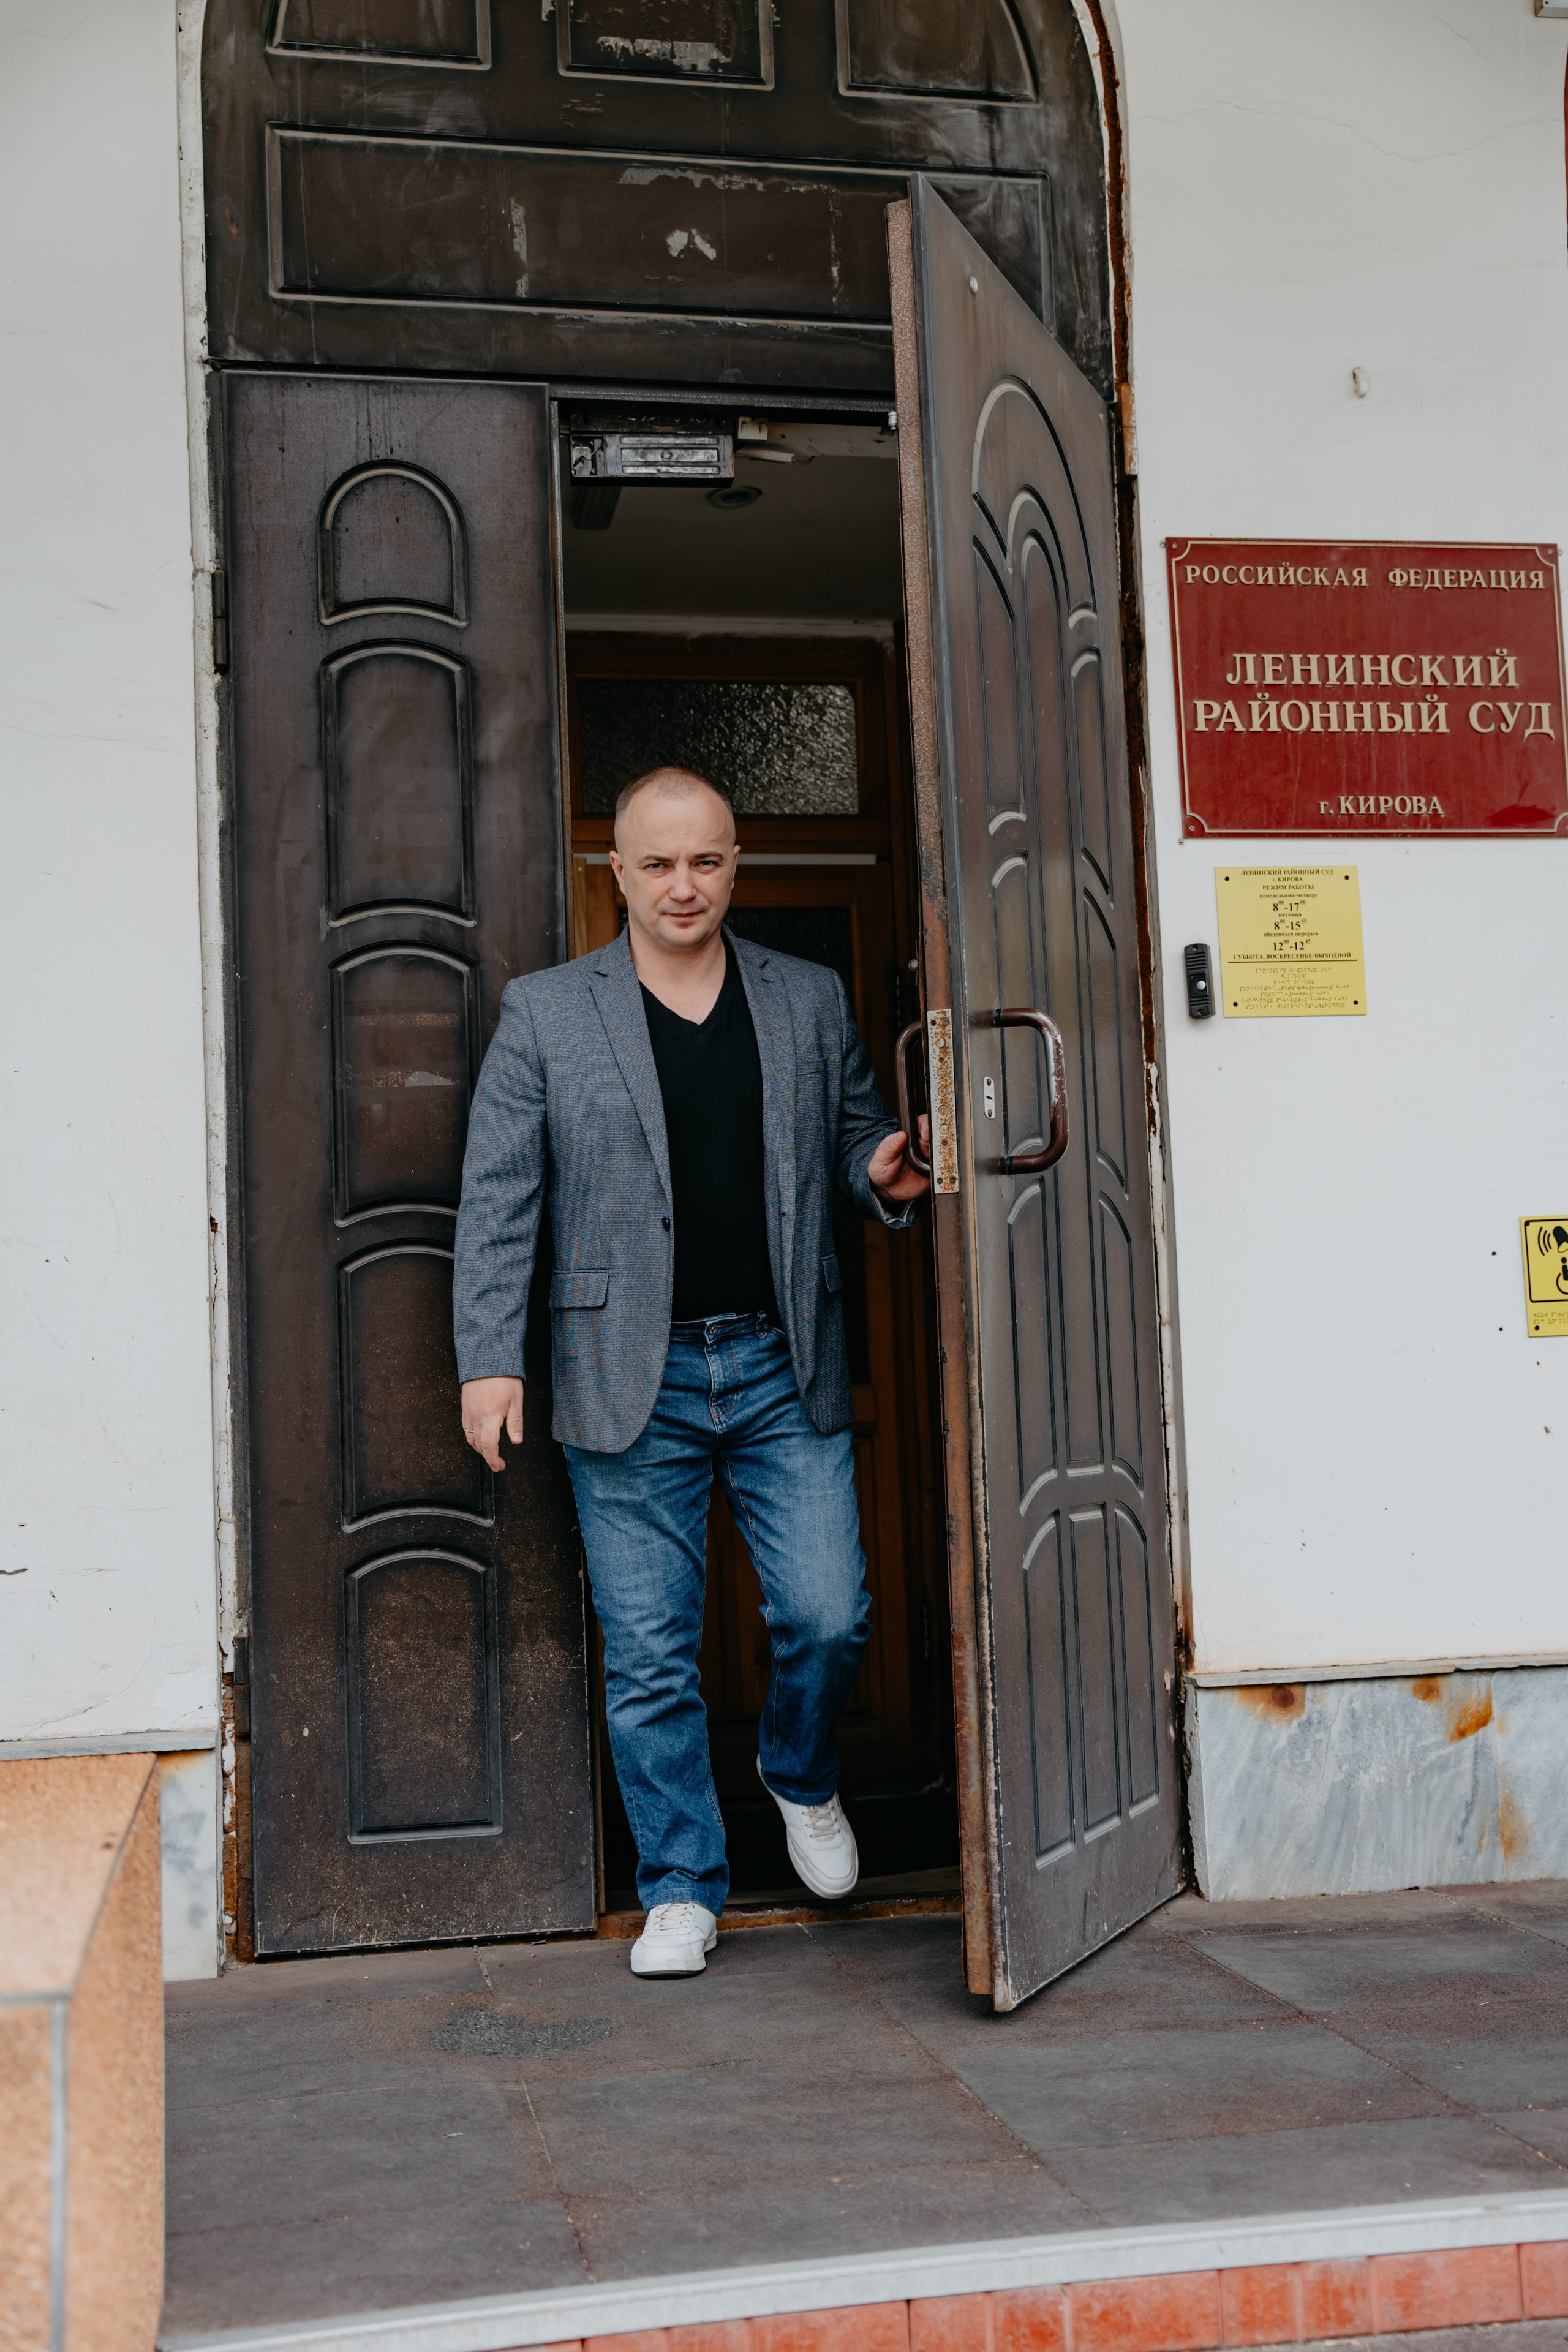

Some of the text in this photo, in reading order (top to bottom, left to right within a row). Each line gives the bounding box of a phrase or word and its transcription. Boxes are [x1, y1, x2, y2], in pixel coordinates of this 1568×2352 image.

[1185, 562, 1545, 592] РОССИЙСКАЯ ФЕДЕРАЦИЯ
[1226, 649, 1520, 688] ЛЕНИНСКИЙ
[1193, 693, 1555, 741] РАЙОННЫЙ СУД
[1318, 795, 1444, 816] г. КИРОВА
